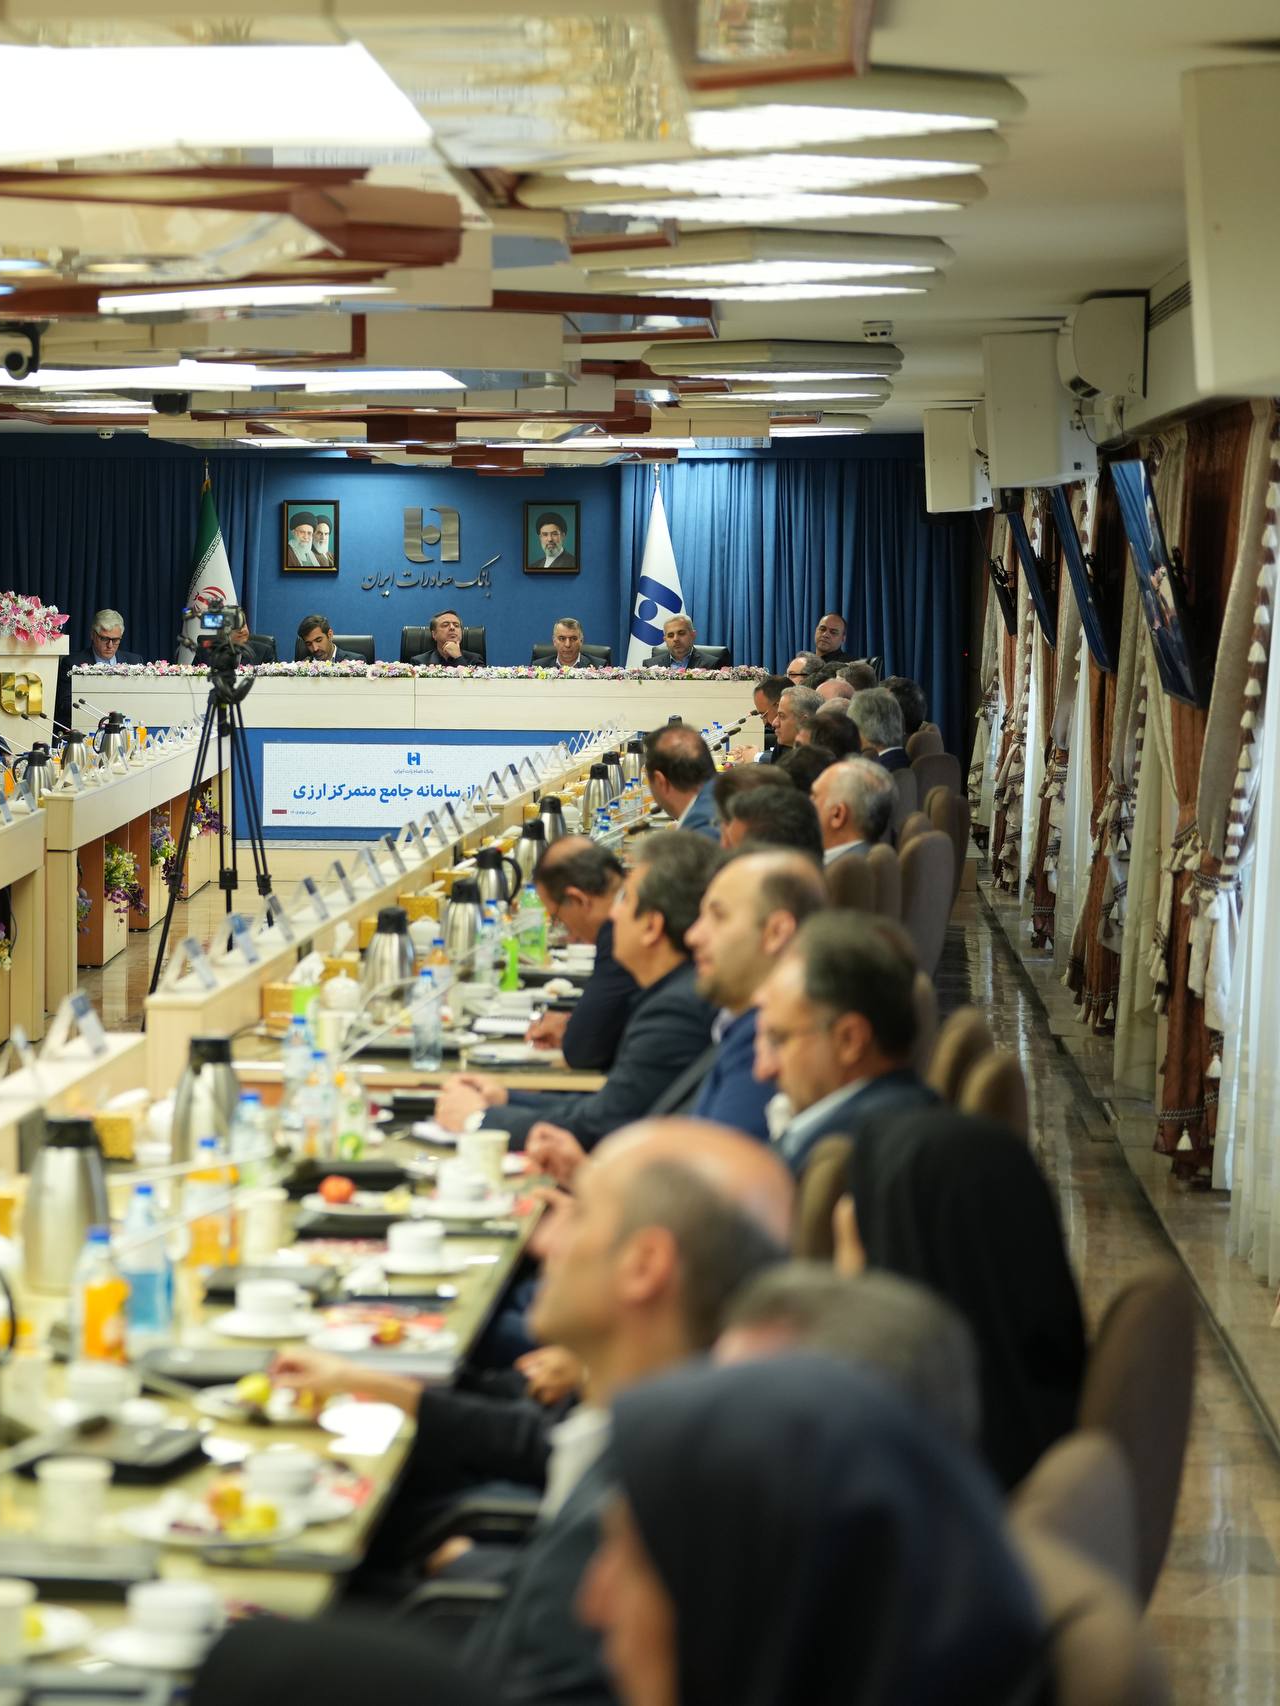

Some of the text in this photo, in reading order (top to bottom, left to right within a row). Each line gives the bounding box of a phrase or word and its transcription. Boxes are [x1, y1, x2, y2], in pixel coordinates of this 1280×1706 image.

[360, 553, 502, 599] بانک صادرات ایران
[293, 783, 326, 801] ارزی
[328, 783, 376, 801] متمرکز
[379, 783, 413, 803] جامع
[417, 784, 461, 799] سامانه
